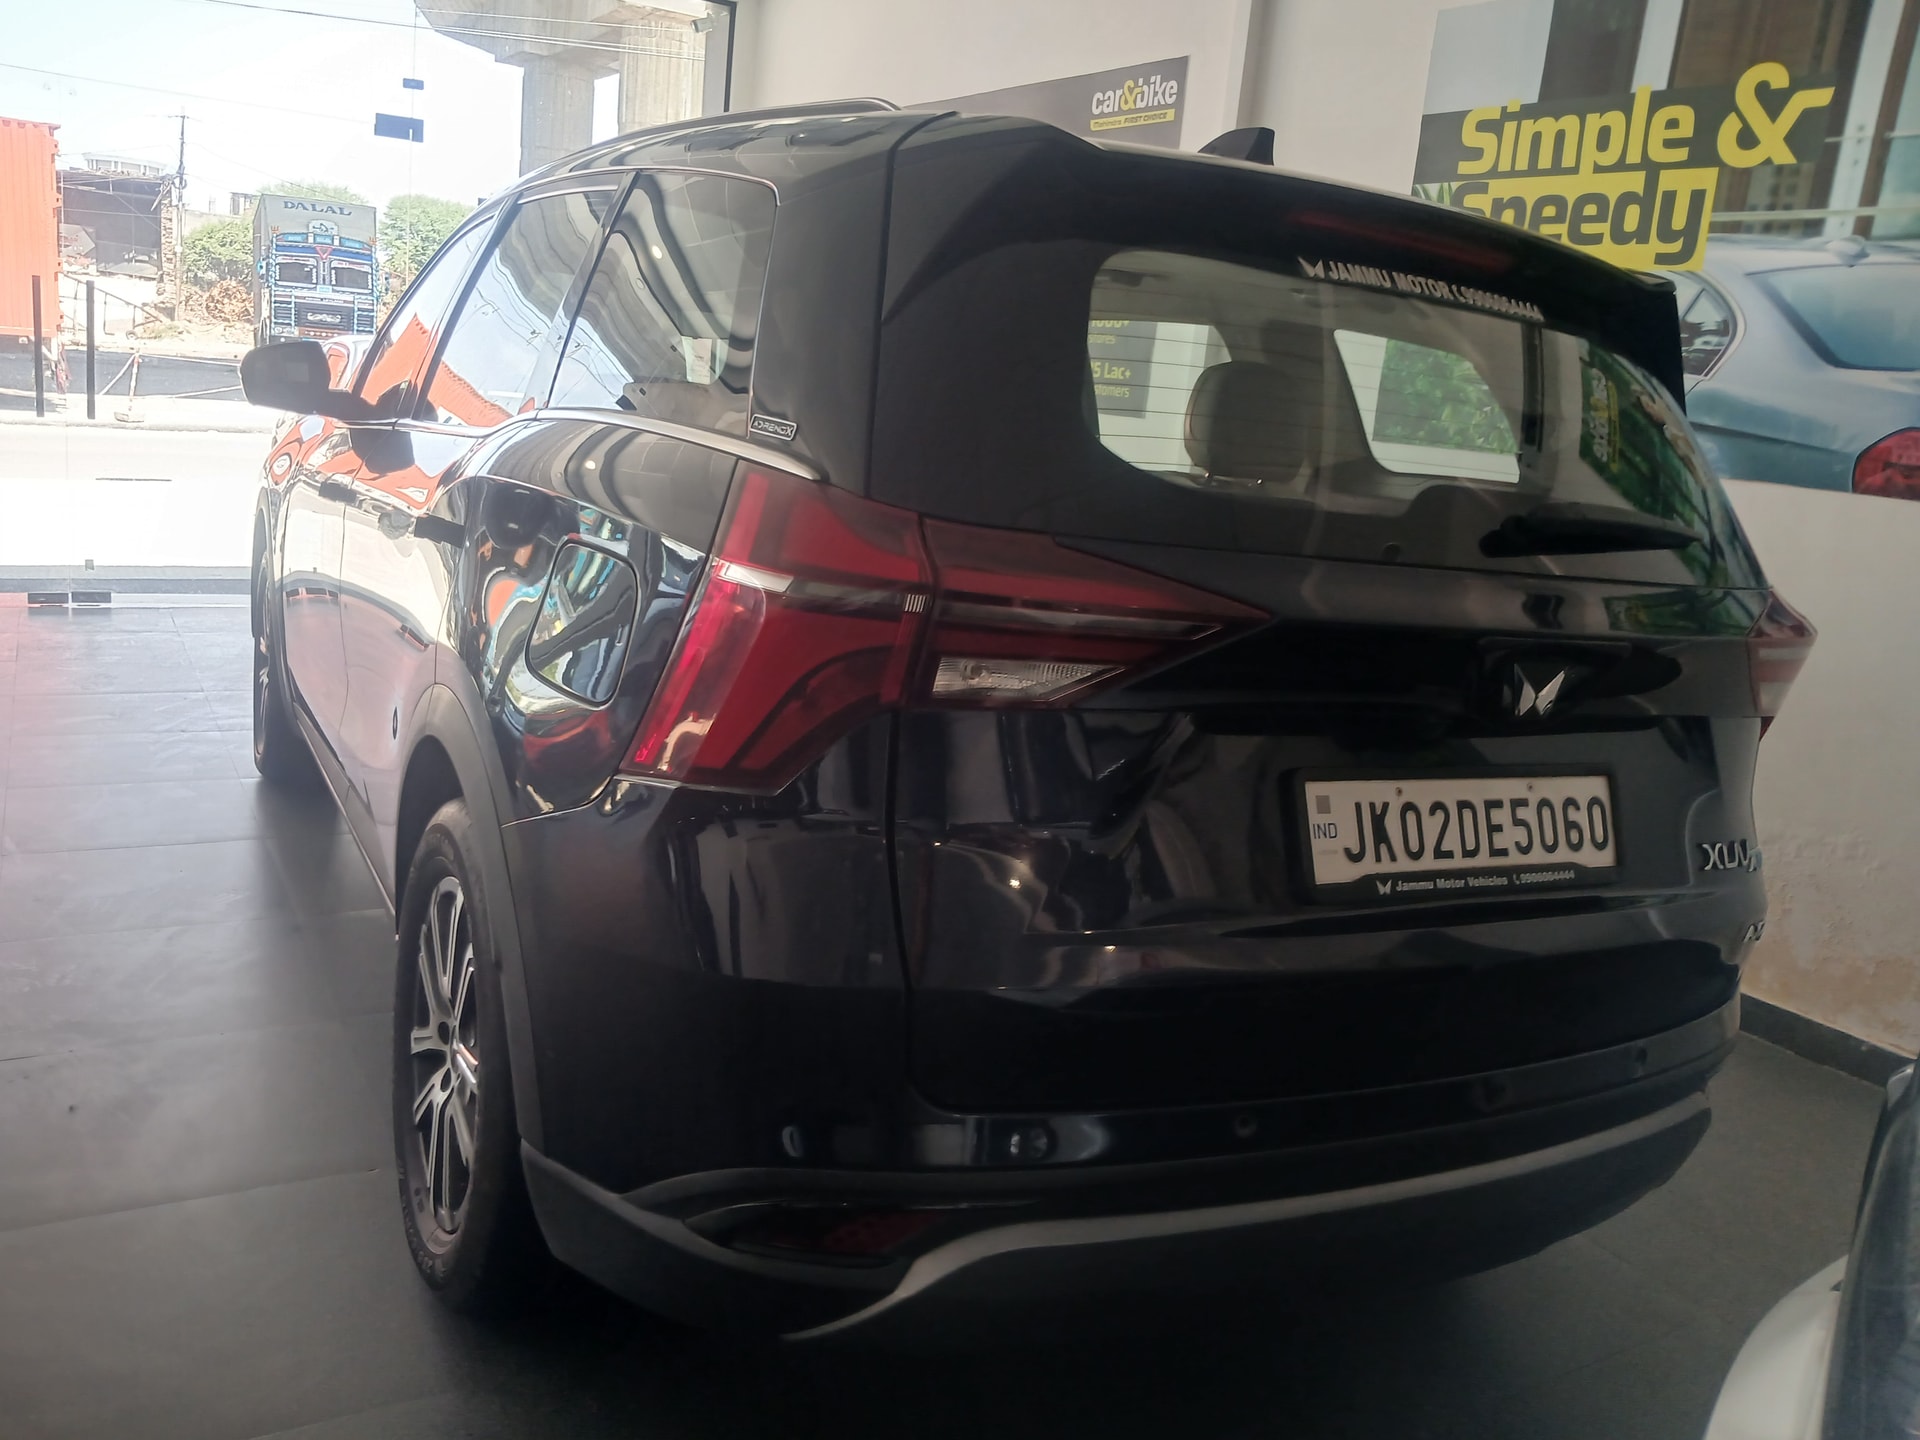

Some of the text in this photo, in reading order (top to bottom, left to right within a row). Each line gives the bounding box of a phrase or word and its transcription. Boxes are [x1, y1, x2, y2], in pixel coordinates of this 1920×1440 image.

[1092, 75, 1178, 115] car&bike
[1457, 62, 1836, 176] Simple &
[283, 200, 352, 216] DALAL
[1328, 260, 1392, 288] JAMMU
[1392, 271, 1454, 300] MOTOR
[1313, 823, 1338, 840] IND
[1343, 796, 1610, 863] JK02DE5060
[1436, 878, 1465, 889] Motor
[1467, 875, 1508, 887] Vehicles
